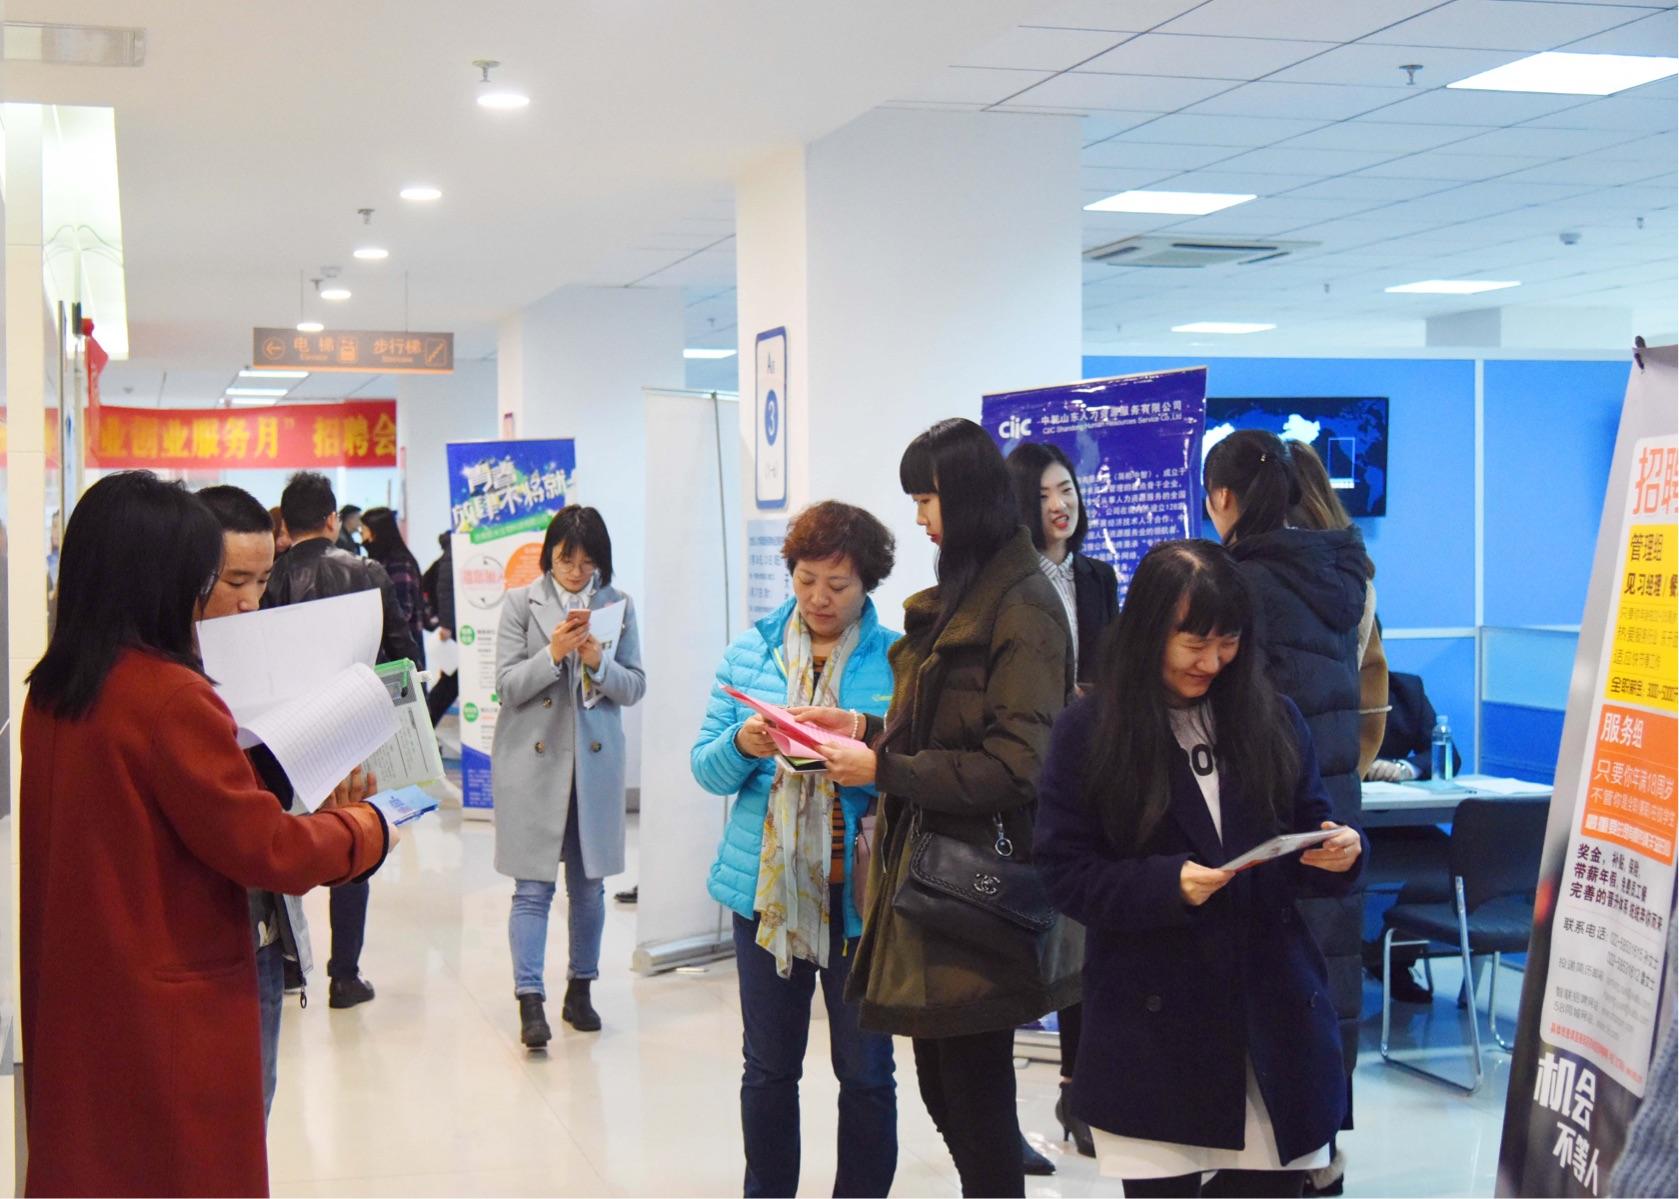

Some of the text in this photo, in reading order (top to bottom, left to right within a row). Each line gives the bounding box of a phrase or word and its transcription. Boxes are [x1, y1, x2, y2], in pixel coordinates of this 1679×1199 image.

[373, 338, 423, 354] 步行梯
[312, 411, 397, 459] 招聘会
[1630, 533, 1663, 562] 管理组
[1600, 712, 1645, 748] 服务组
[1533, 1051, 1596, 1132] 机会
[1552, 1121, 1599, 1197] 不等人
